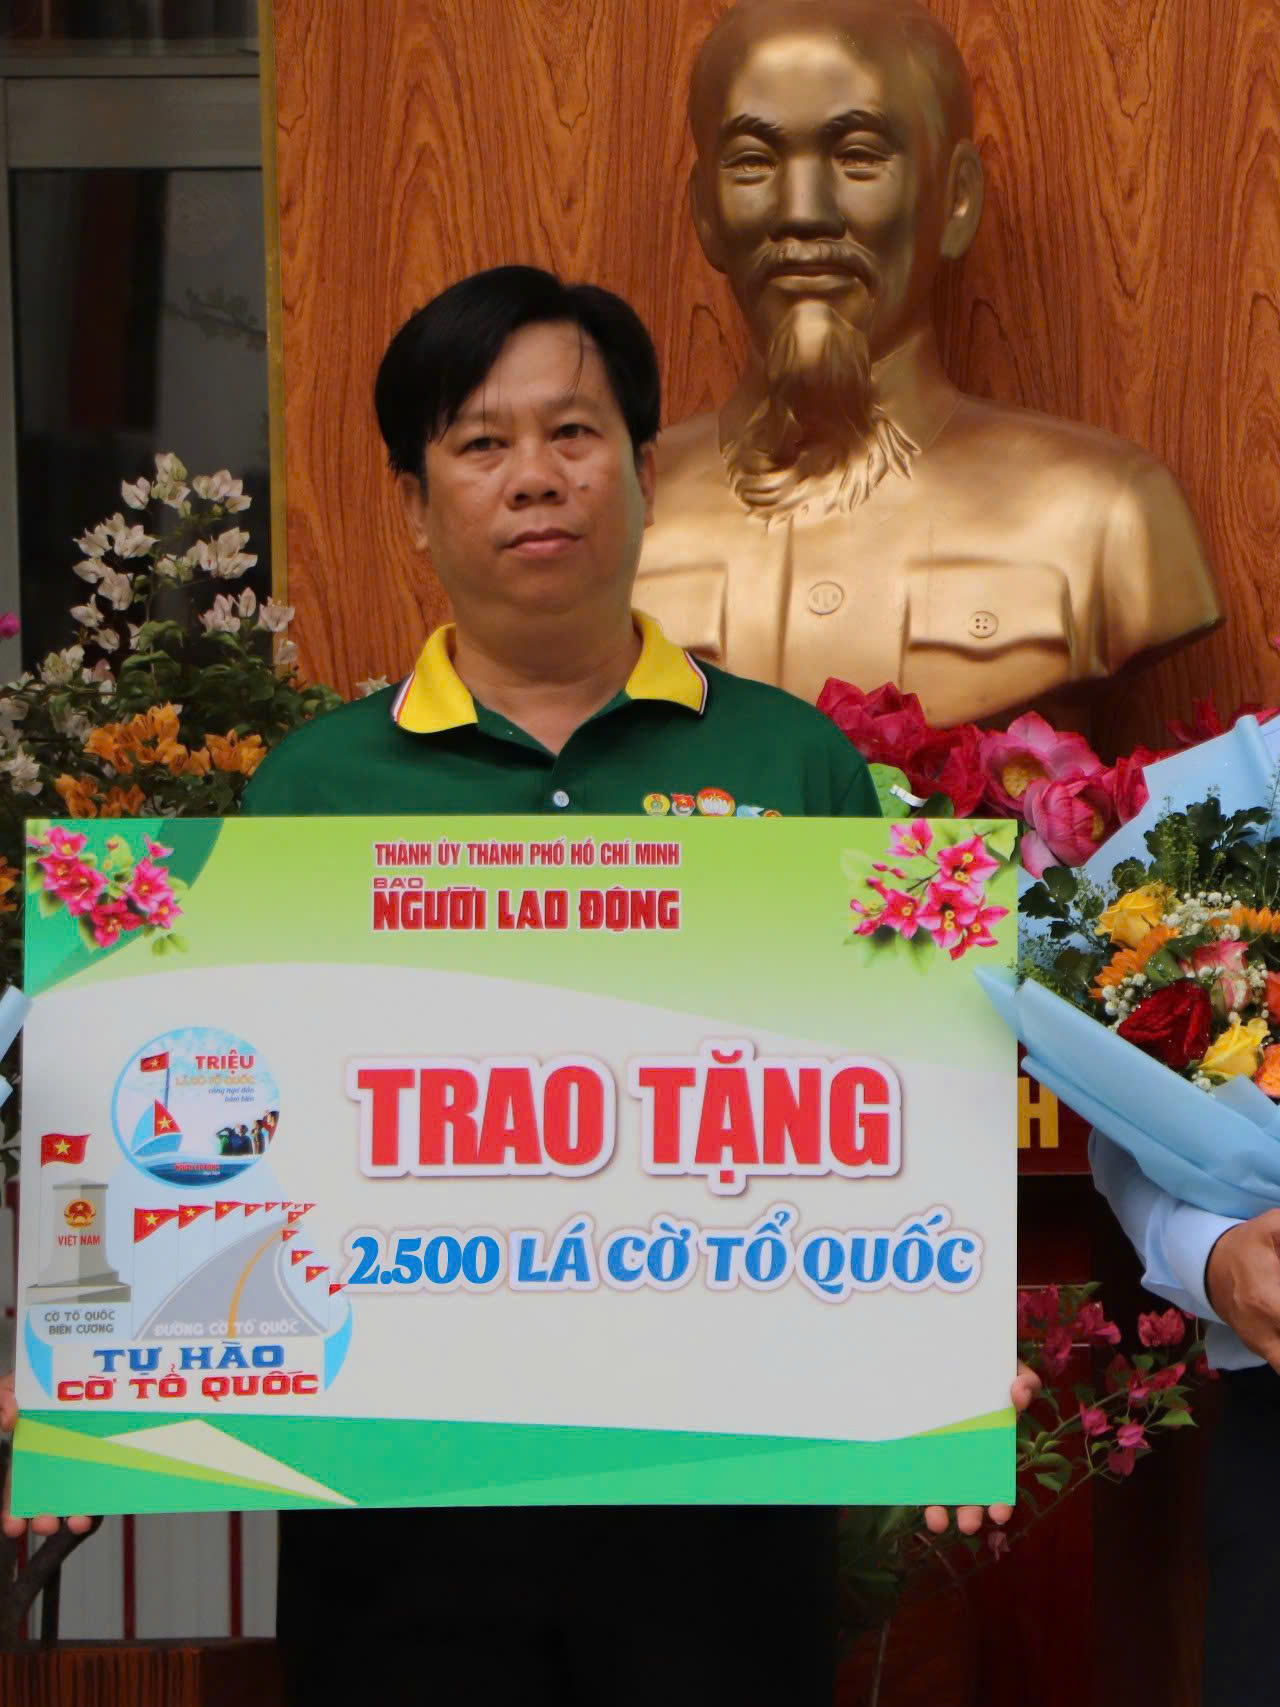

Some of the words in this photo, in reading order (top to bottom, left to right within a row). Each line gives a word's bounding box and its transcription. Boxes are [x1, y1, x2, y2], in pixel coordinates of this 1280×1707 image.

[375, 840, 432, 866] THÀNH
[438, 838, 461, 866] ỦY
[467, 840, 523, 866] THÀNH
[529, 838, 566, 866] PHỐ
[571, 838, 596, 866] HỒ
[601, 839, 631, 866] CHÍ
[635, 843, 680, 866] MINH
[374, 886, 486, 930] NGƯỜI
[497, 889, 569, 930] LAO
[578, 886, 681, 932] ĐỘNG
[195, 1048, 256, 1075] TRIỆU
[356, 1065, 605, 1167] TRAO
[638, 1049, 890, 1185] TẶNG
[347, 1235, 501, 1285] 2.500
[516, 1222, 591, 1283] LÁ
[606, 1221, 692, 1283] CỜ
[705, 1210, 793, 1283] TỔ
[801, 1213, 980, 1295] QUỐC
[93, 1346, 163, 1376] TỰ
[179, 1341, 286, 1371] HÀO
[56, 1375, 118, 1402] CỜ
[128, 1363, 188, 1400] TỔ
[201, 1370, 320, 1402] QUỐC
